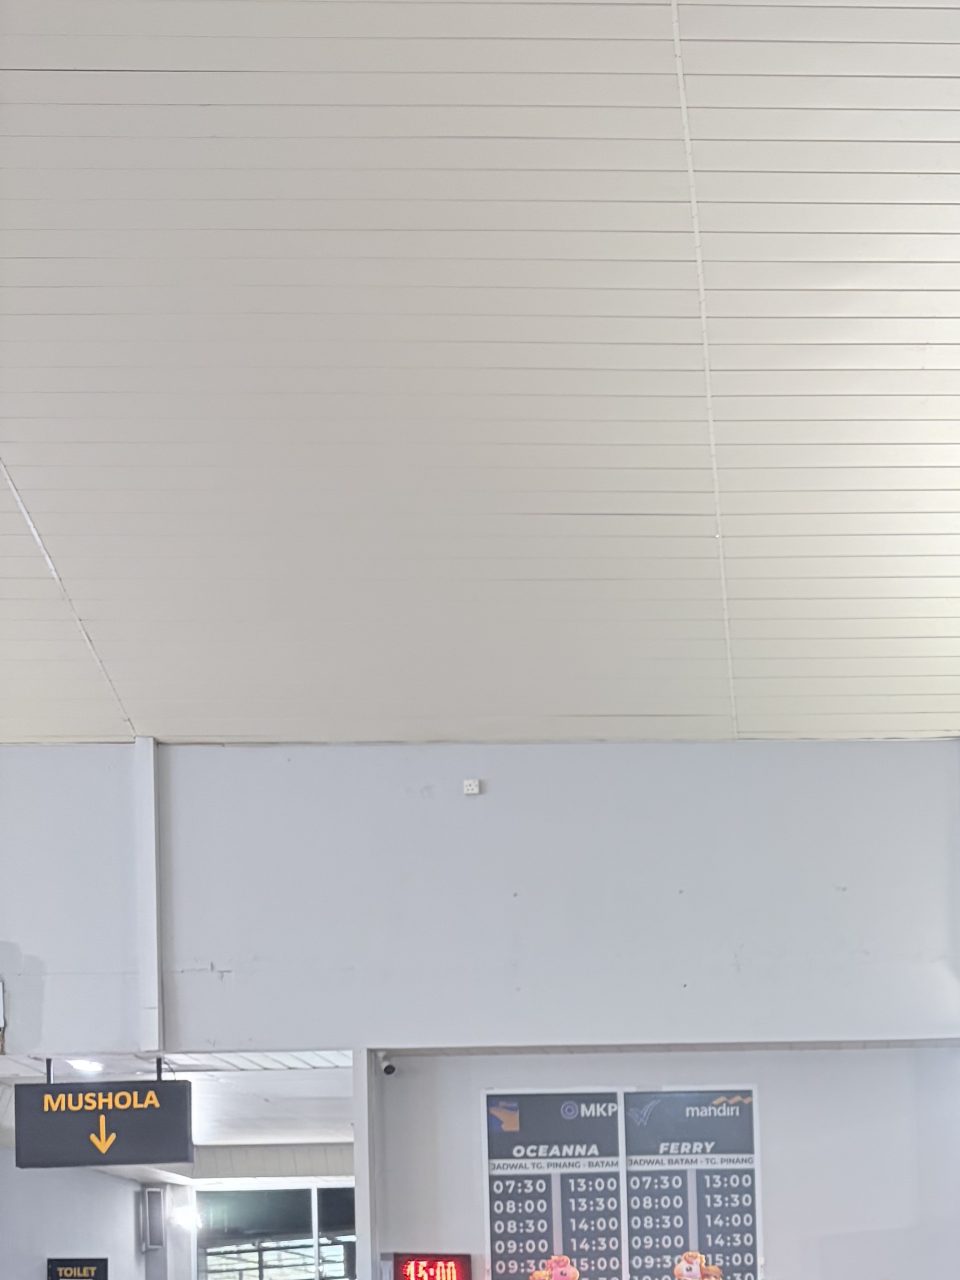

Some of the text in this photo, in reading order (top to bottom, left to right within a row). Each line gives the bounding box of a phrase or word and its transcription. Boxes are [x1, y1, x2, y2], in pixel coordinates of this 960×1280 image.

[43, 1089, 160, 1112] MUSHOLA
[580, 1102, 618, 1117] MKP
[685, 1103, 740, 1117] mandiri
[512, 1144, 599, 1157] OCEANNA
[659, 1141, 715, 1154] FERRY
[587, 1160, 618, 1169] BATAM
[668, 1158, 698, 1166] BATAM
[493, 1180, 546, 1193] 07:30
[569, 1178, 617, 1191] 13:00
[630, 1176, 682, 1189] 07:30
[705, 1175, 751, 1188] 13:00
[494, 1200, 547, 1213] 08:00
[569, 1198, 617, 1211] 13:30
[631, 1196, 683, 1209] 08:00
[705, 1194, 752, 1207] 13:30
[495, 1220, 547, 1233] 08:30
[570, 1218, 618, 1231] 14:00
[631, 1216, 683, 1229] 08:30
[706, 1214, 752, 1227] 14:00
[495, 1240, 548, 1253] 09:00
[571, 1237, 618, 1251] 14:30
[632, 1235, 684, 1249] 09:00
[706, 1234, 753, 1246] 14:30
[57, 1266, 97, 1278] TOILET
